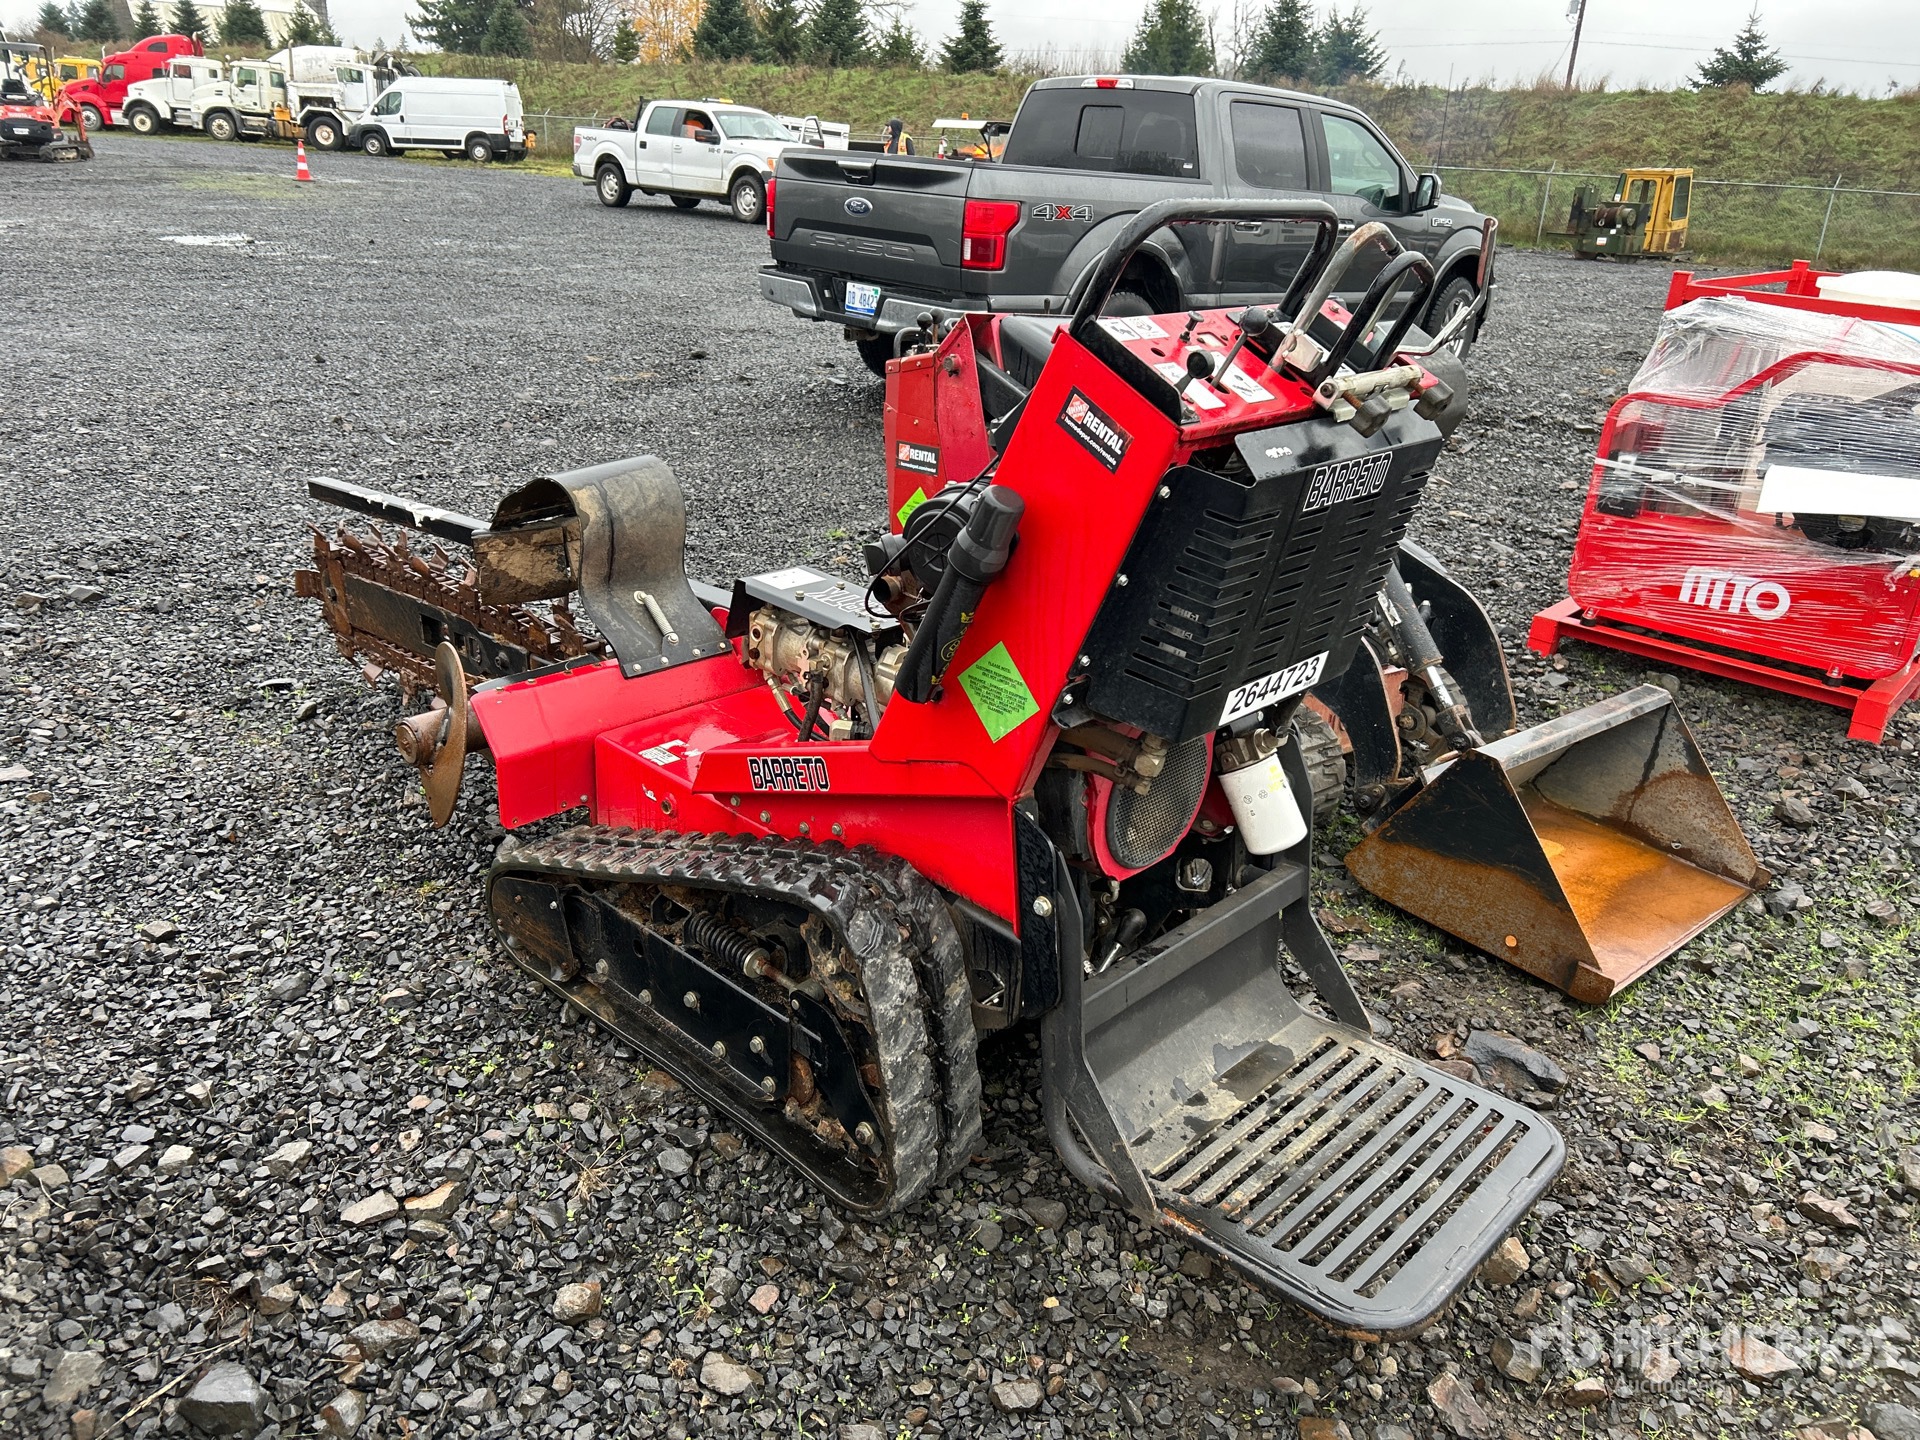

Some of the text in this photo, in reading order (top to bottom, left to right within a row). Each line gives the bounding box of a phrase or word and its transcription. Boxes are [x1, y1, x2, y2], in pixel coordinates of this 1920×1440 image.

[1083, 410, 1123, 455] RENTAL
[910, 448, 937, 464] RENTAL
[1303, 451, 1393, 512] BARRETO
[1229, 656, 1320, 715] 2644723
[747, 756, 830, 792] BARRETO
